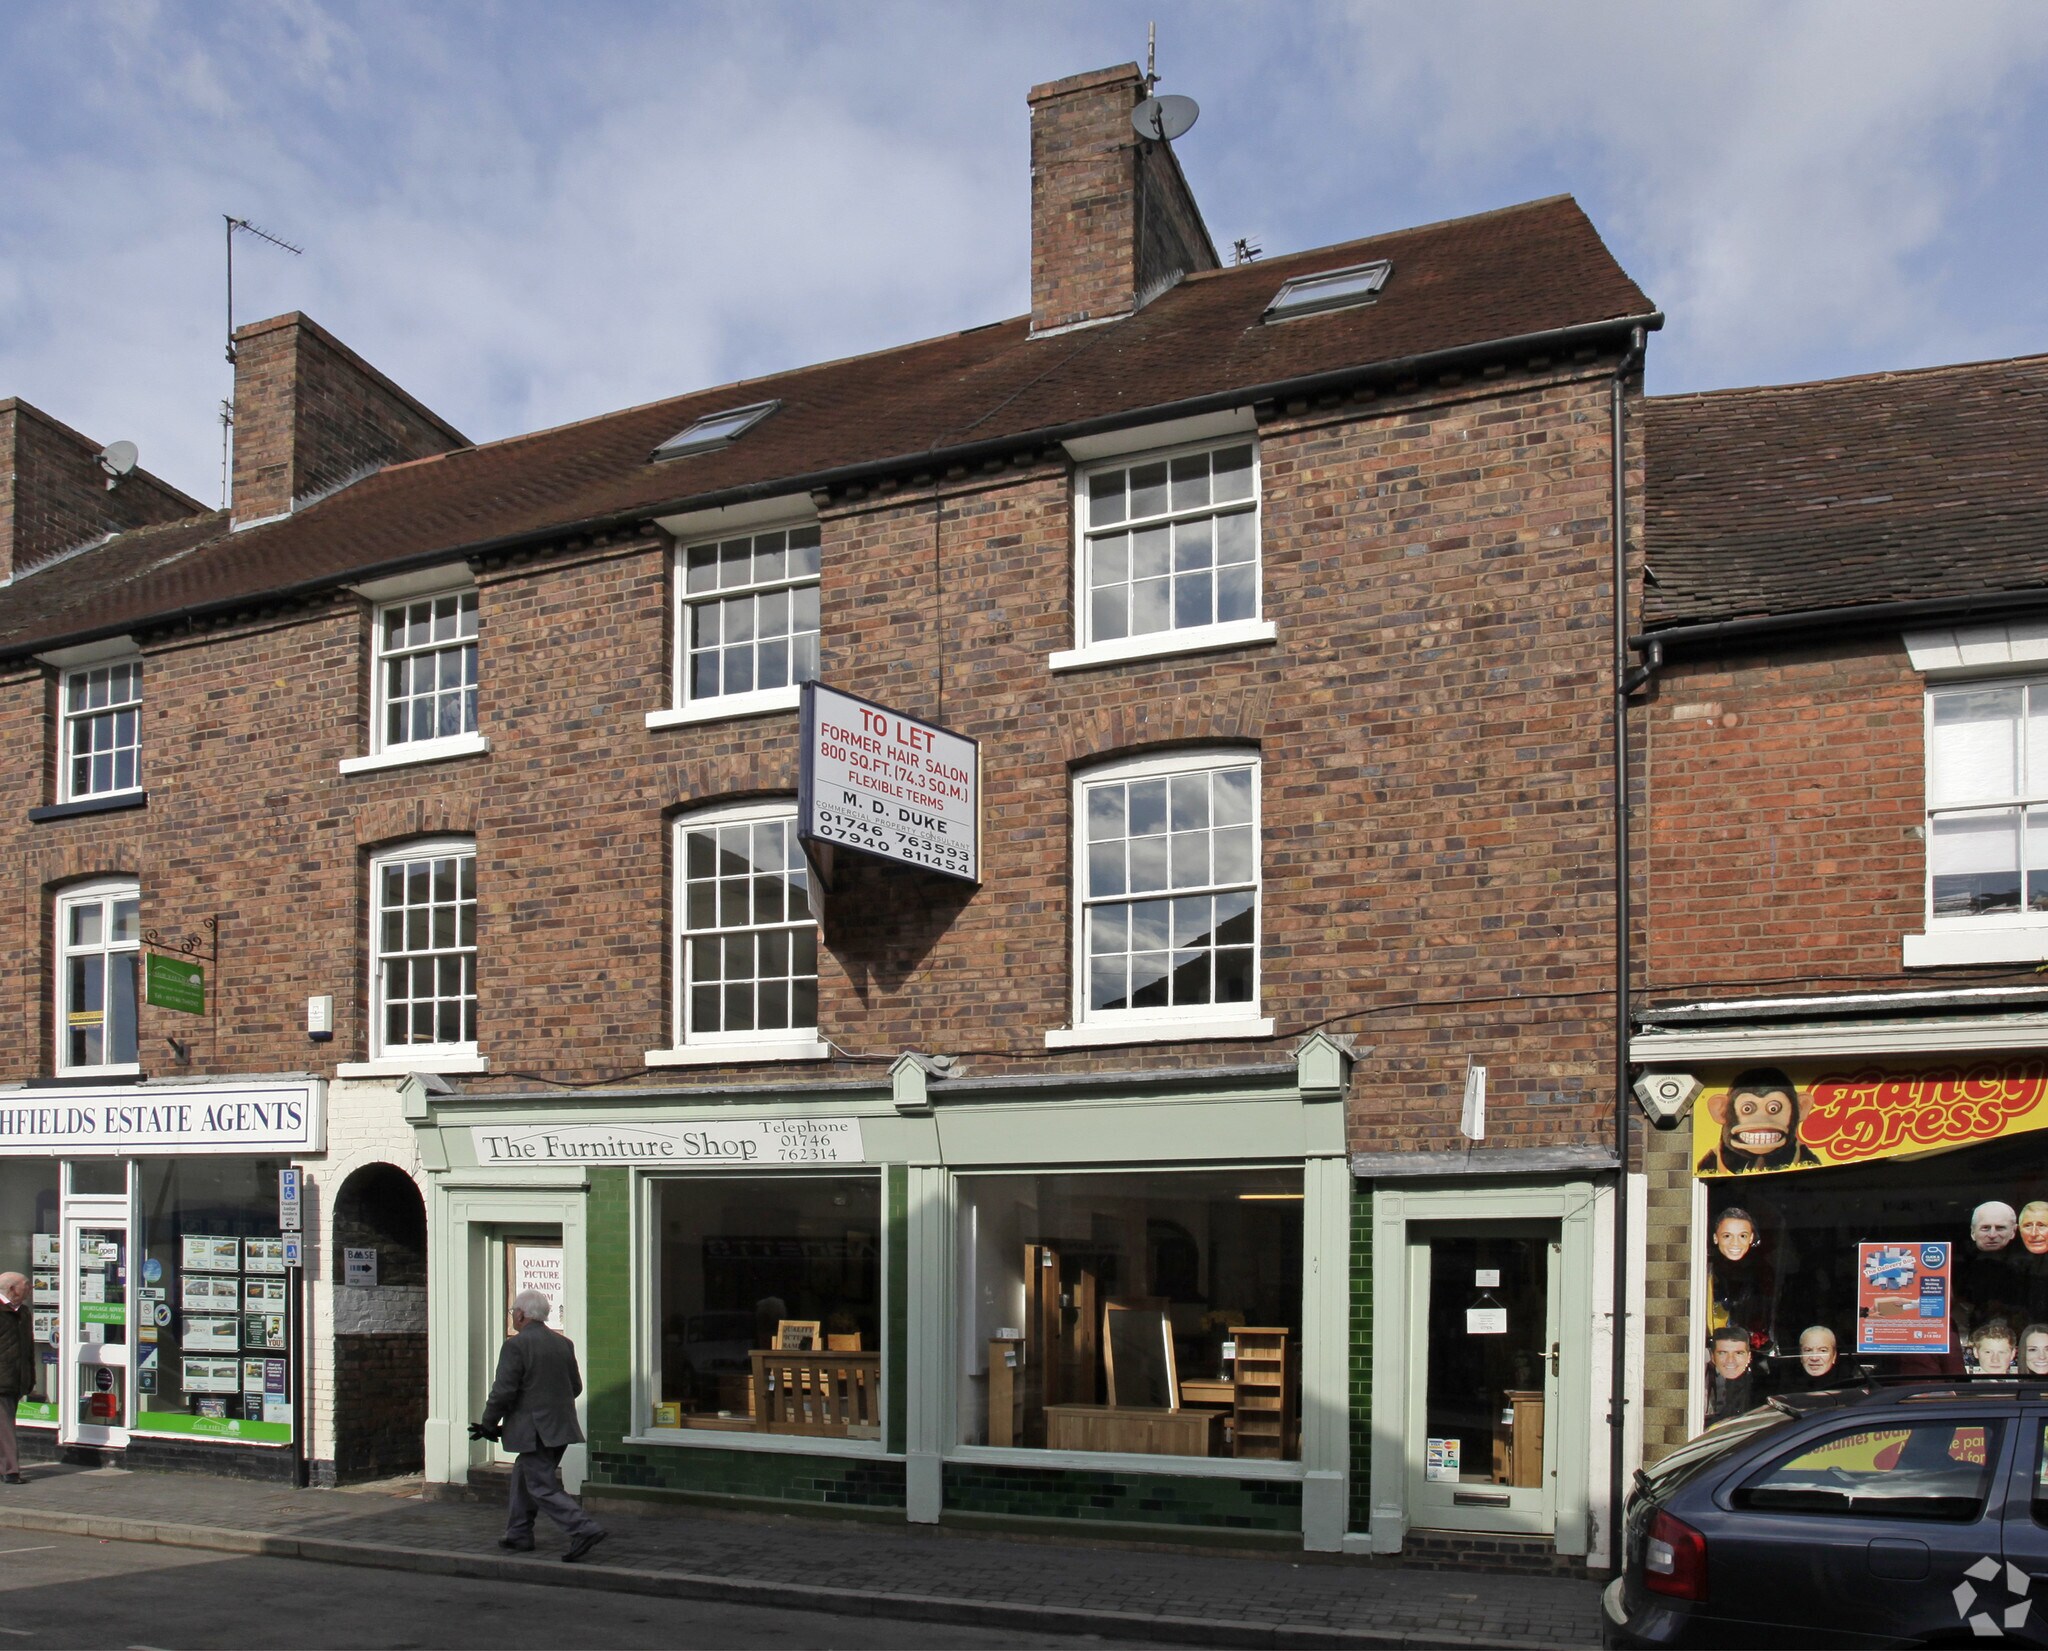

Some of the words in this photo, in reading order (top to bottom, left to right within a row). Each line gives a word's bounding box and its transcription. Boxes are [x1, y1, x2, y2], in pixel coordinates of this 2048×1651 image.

[859, 707, 888, 738] TO
[896, 721, 936, 754] LET
[820, 742, 847, 762] 800
[850, 751, 892, 777] SQ.FT.
[894, 764, 926, 788] (74.3
[928, 778, 969, 803] SQ.M.)
[821, 722, 882, 756] FORMER
[887, 745, 920, 769] HAIR
[925, 758, 969, 785] SALON
[848, 770, 904, 800] FLEXIBLE
[906, 788, 945, 812] TERMS
[815, 800, 871, 822] COMMERCIAL
[875, 817, 917, 835] PROPERTY
[920, 831, 970, 850] CONSULTANT
[843, 791, 863, 809] M.
[872, 800, 890, 817] D.
[899, 807, 948, 834] DUKE
[819, 810, 883, 837] 01746
[895, 832, 970, 862] 763593
[820, 825, 890, 852] 07940
[902, 847, 969, 875] 811454
[104, 1104, 193, 1134] ESTATE
[200, 1101, 302, 1132] AGENTS
[1799, 1059, 2046, 1143] Fancy
[482, 1136, 537, 1159] The
[542, 1135, 675, 1158] Furniture
[683, 1132, 757, 1161] Shop
[759, 1120, 849, 1135] Telephone
[780, 1134, 831, 1147] 01746
[1831, 1098, 2003, 1156] Dress
[777, 1148, 838, 1161] 762314
[522, 1259, 561, 1269] QUALITY
[523, 1270, 560, 1280] PICTURE
[522, 1281, 562, 1291] FRAMING
